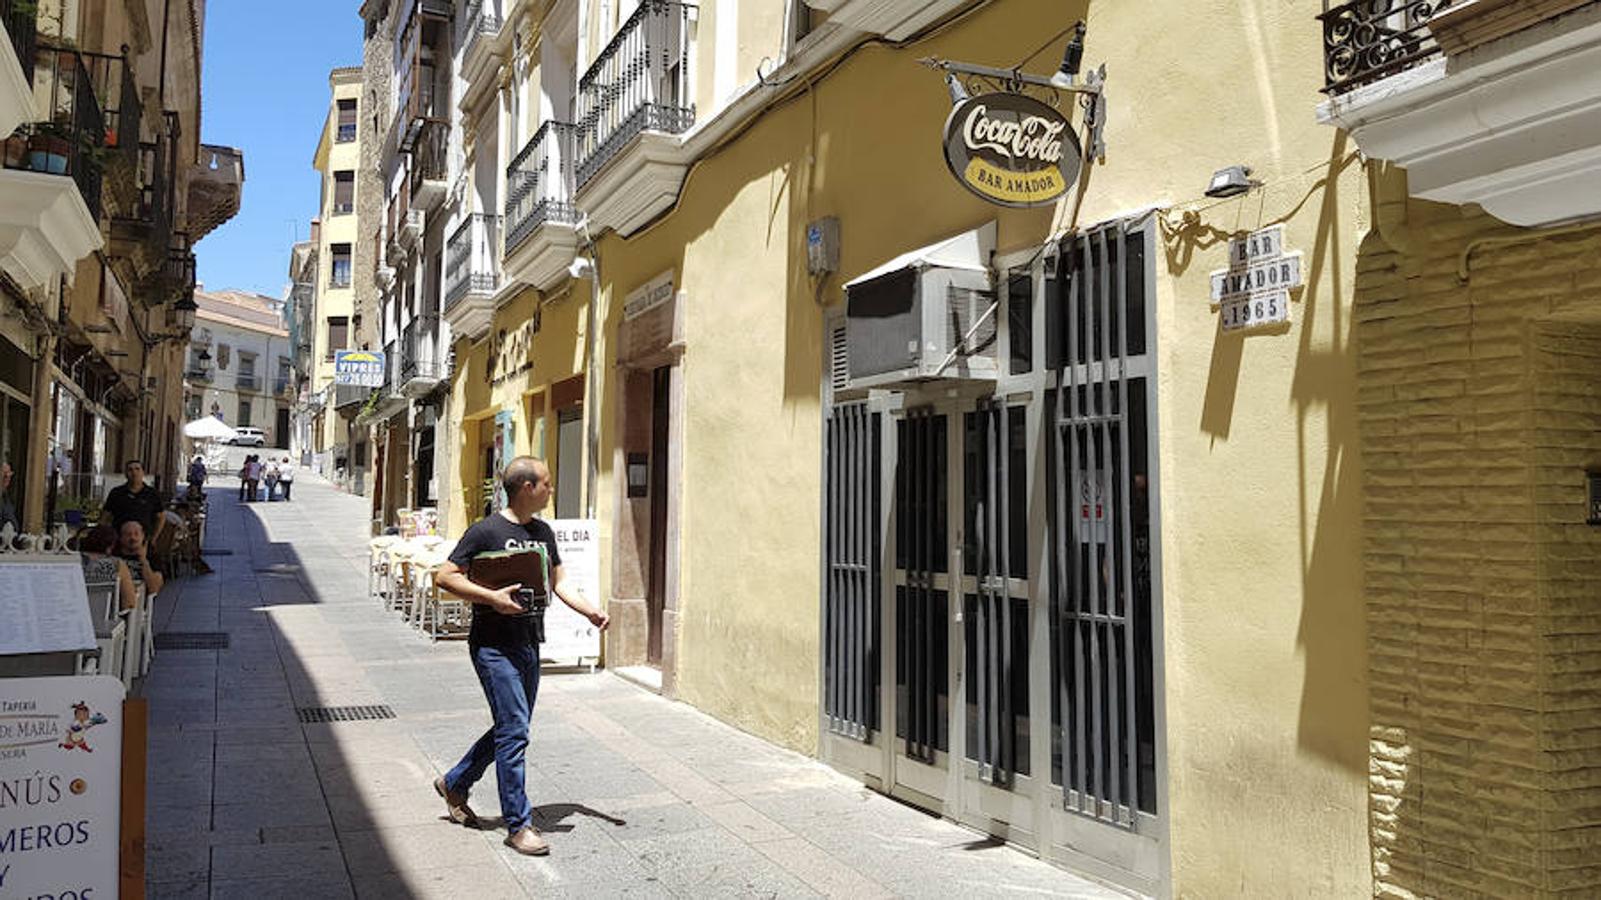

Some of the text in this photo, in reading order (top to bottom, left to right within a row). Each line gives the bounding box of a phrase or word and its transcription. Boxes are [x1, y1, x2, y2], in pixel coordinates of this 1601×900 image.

[977, 169, 1055, 193] BAR AMADOR
[1239, 236, 1272, 260] BAR
[1220, 264, 1291, 295] AMADOR
